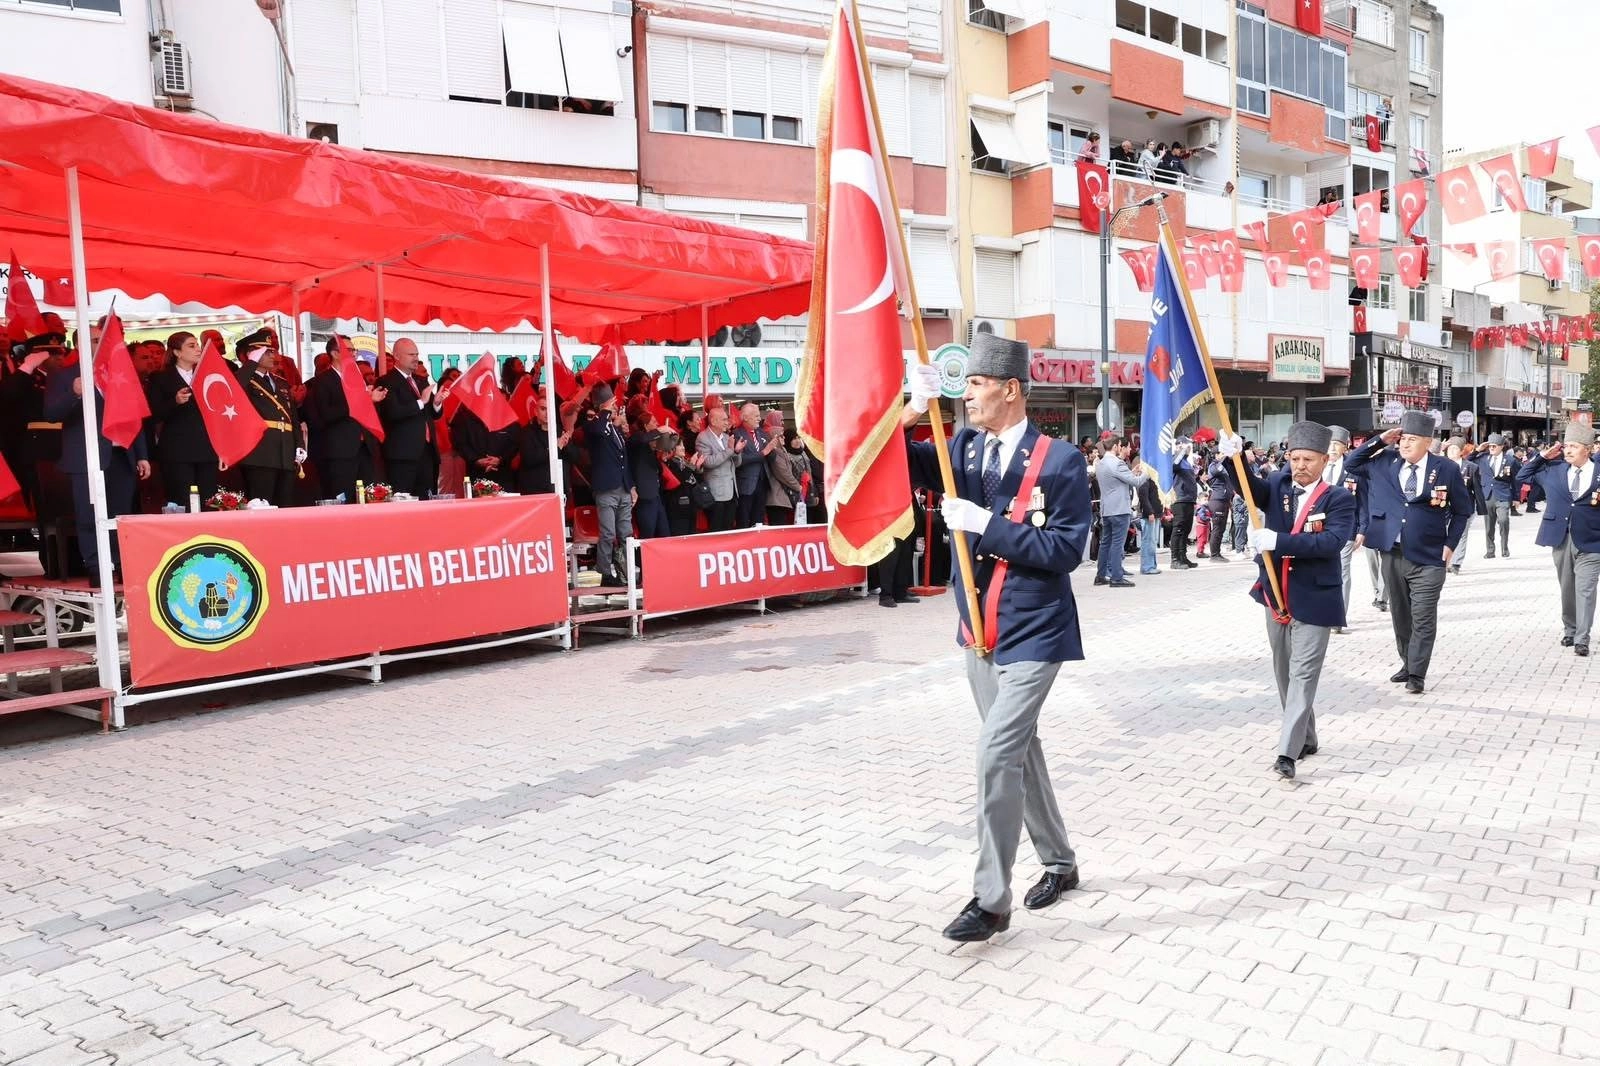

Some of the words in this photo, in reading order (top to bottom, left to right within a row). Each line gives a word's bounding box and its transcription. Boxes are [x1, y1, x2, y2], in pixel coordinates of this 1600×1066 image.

[1031, 352, 1096, 384] ÖZDE
[1109, 360, 1145, 385] KA
[1275, 339, 1321, 362] KARAKAŞLAR
[281, 552, 424, 604] MENEMEN
[428, 534, 554, 587] BELEDİYESİ
[698, 541, 834, 588] PROTOKOL
